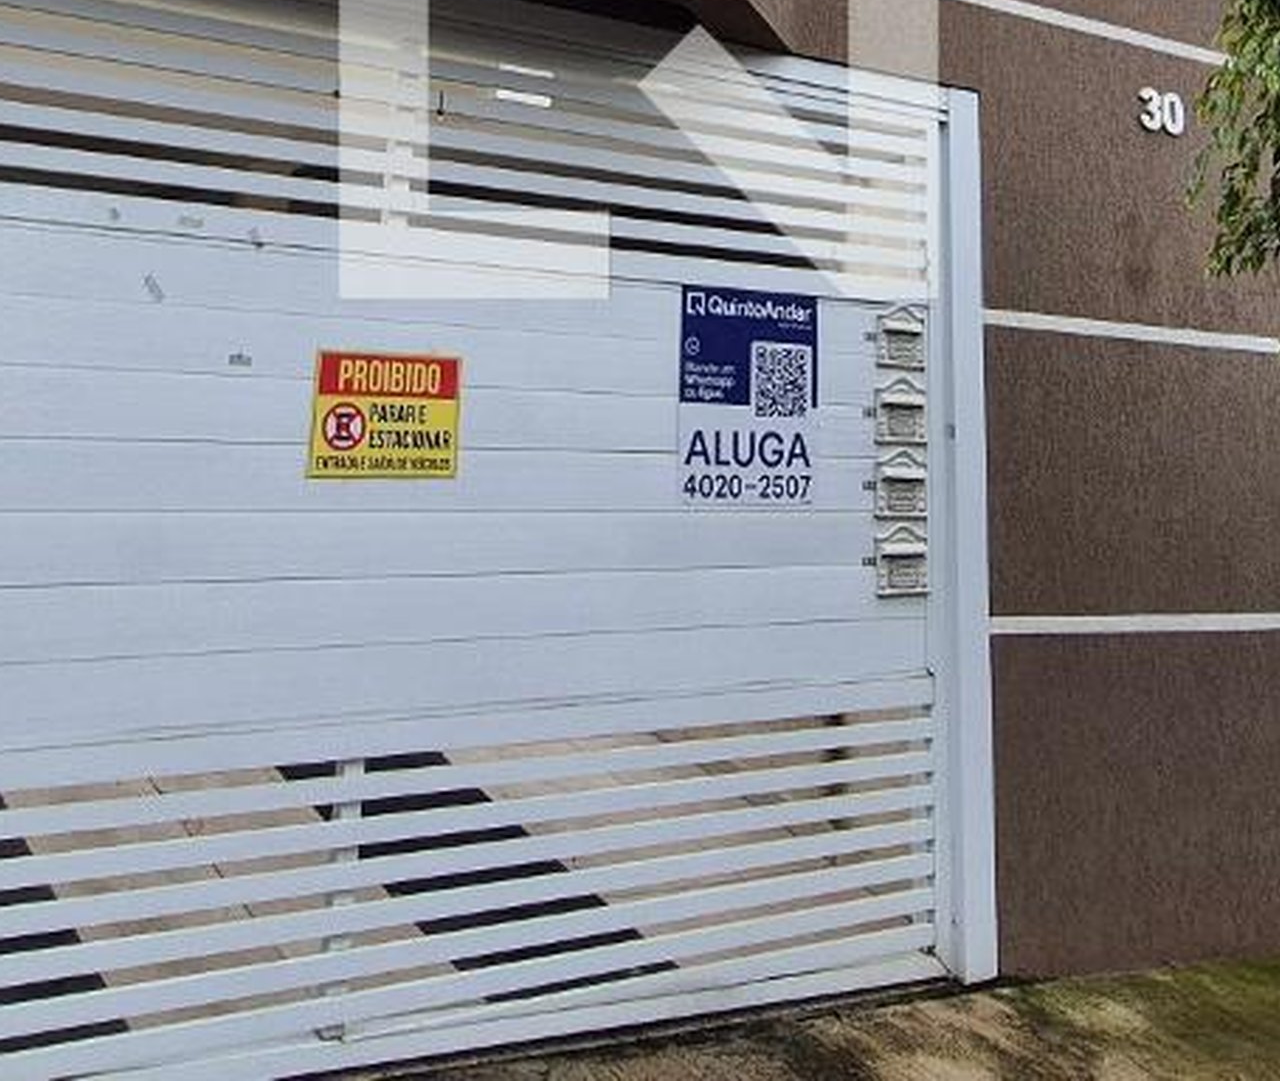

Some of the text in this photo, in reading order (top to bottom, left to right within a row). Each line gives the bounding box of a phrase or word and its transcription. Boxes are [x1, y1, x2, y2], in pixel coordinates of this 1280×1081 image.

[1139, 87, 1184, 136] 30
[708, 295, 812, 321] QuintoAndar
[338, 360, 441, 394] PROIBIDO
[369, 403, 427, 424] PARAR E
[369, 430, 452, 450] ESTACIONAR
[684, 430, 811, 468] ALUGA
[683, 474, 812, 499] 4020-2507
